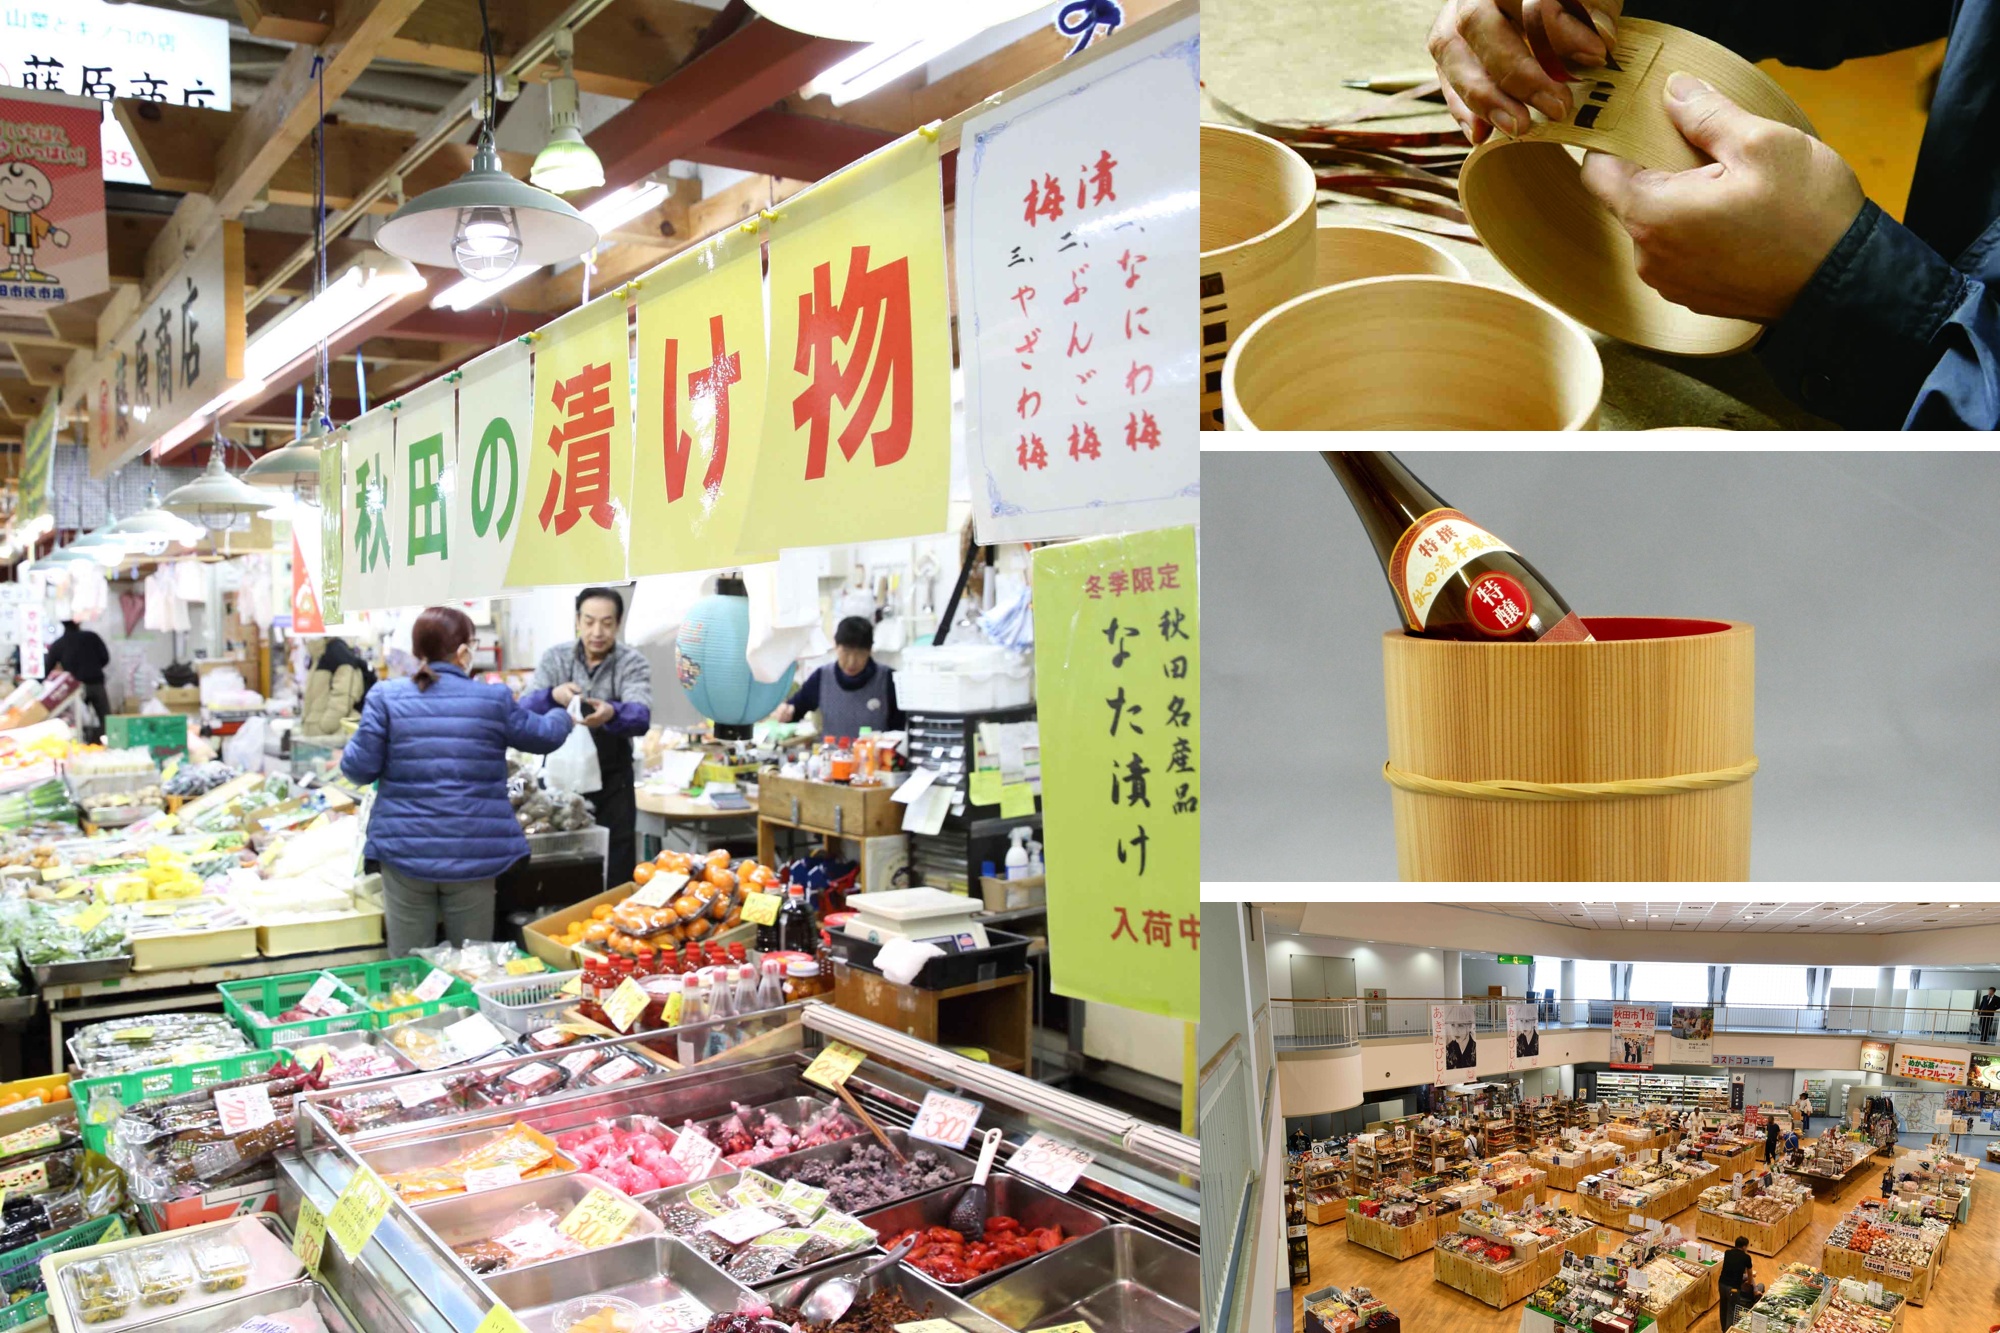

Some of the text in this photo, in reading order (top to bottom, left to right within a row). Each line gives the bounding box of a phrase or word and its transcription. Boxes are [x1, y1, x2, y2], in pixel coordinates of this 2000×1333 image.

[105, 150, 133, 167] 35
[1084, 562, 1181, 599] 冬季限定
[1158, 607, 1198, 815] 秋田名産品
[1102, 617, 1150, 876] なた漬け
[1613, 1007, 1655, 1021] 秋田市1位
[1713, 1056, 1774, 1065] コストココーナー
[1907, 1066, 1956, 1079] ドライフルーツ
[925, 1111, 967, 1142] 300
